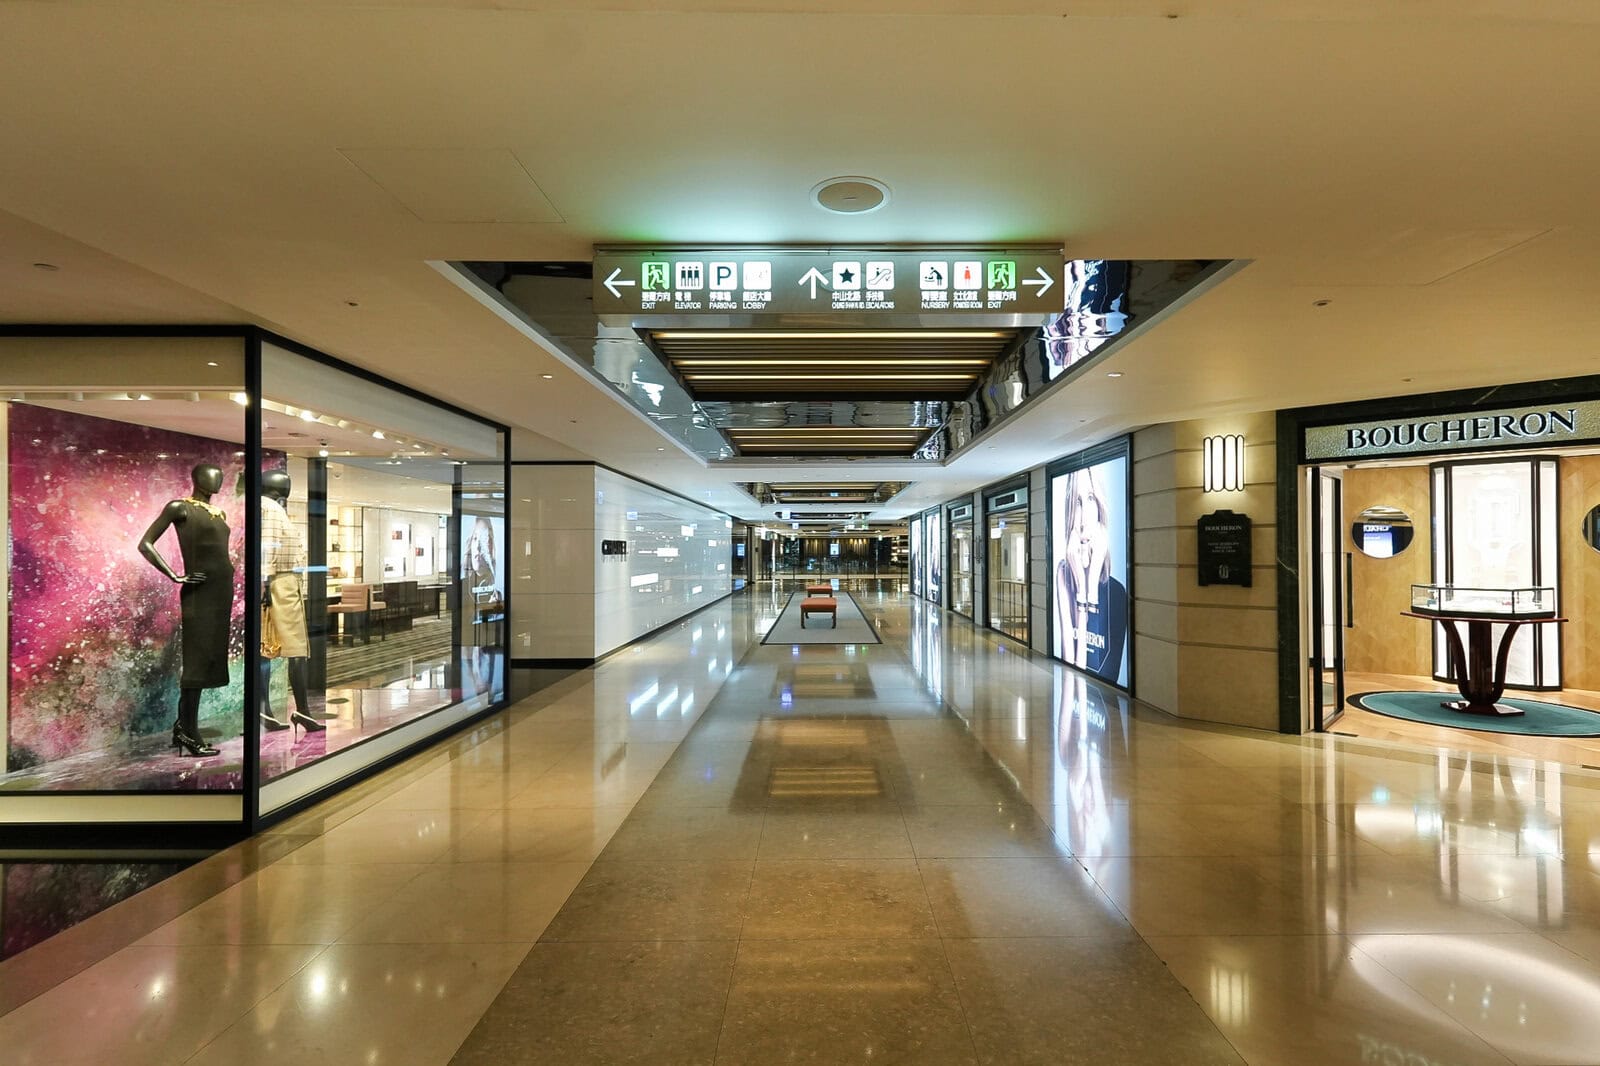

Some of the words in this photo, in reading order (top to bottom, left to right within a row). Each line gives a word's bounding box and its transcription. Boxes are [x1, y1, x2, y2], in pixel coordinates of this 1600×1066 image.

[921, 301, 950, 309] NURSERY
[988, 301, 1002, 309] EXIT
[1345, 408, 1577, 450] BOUCHERON
